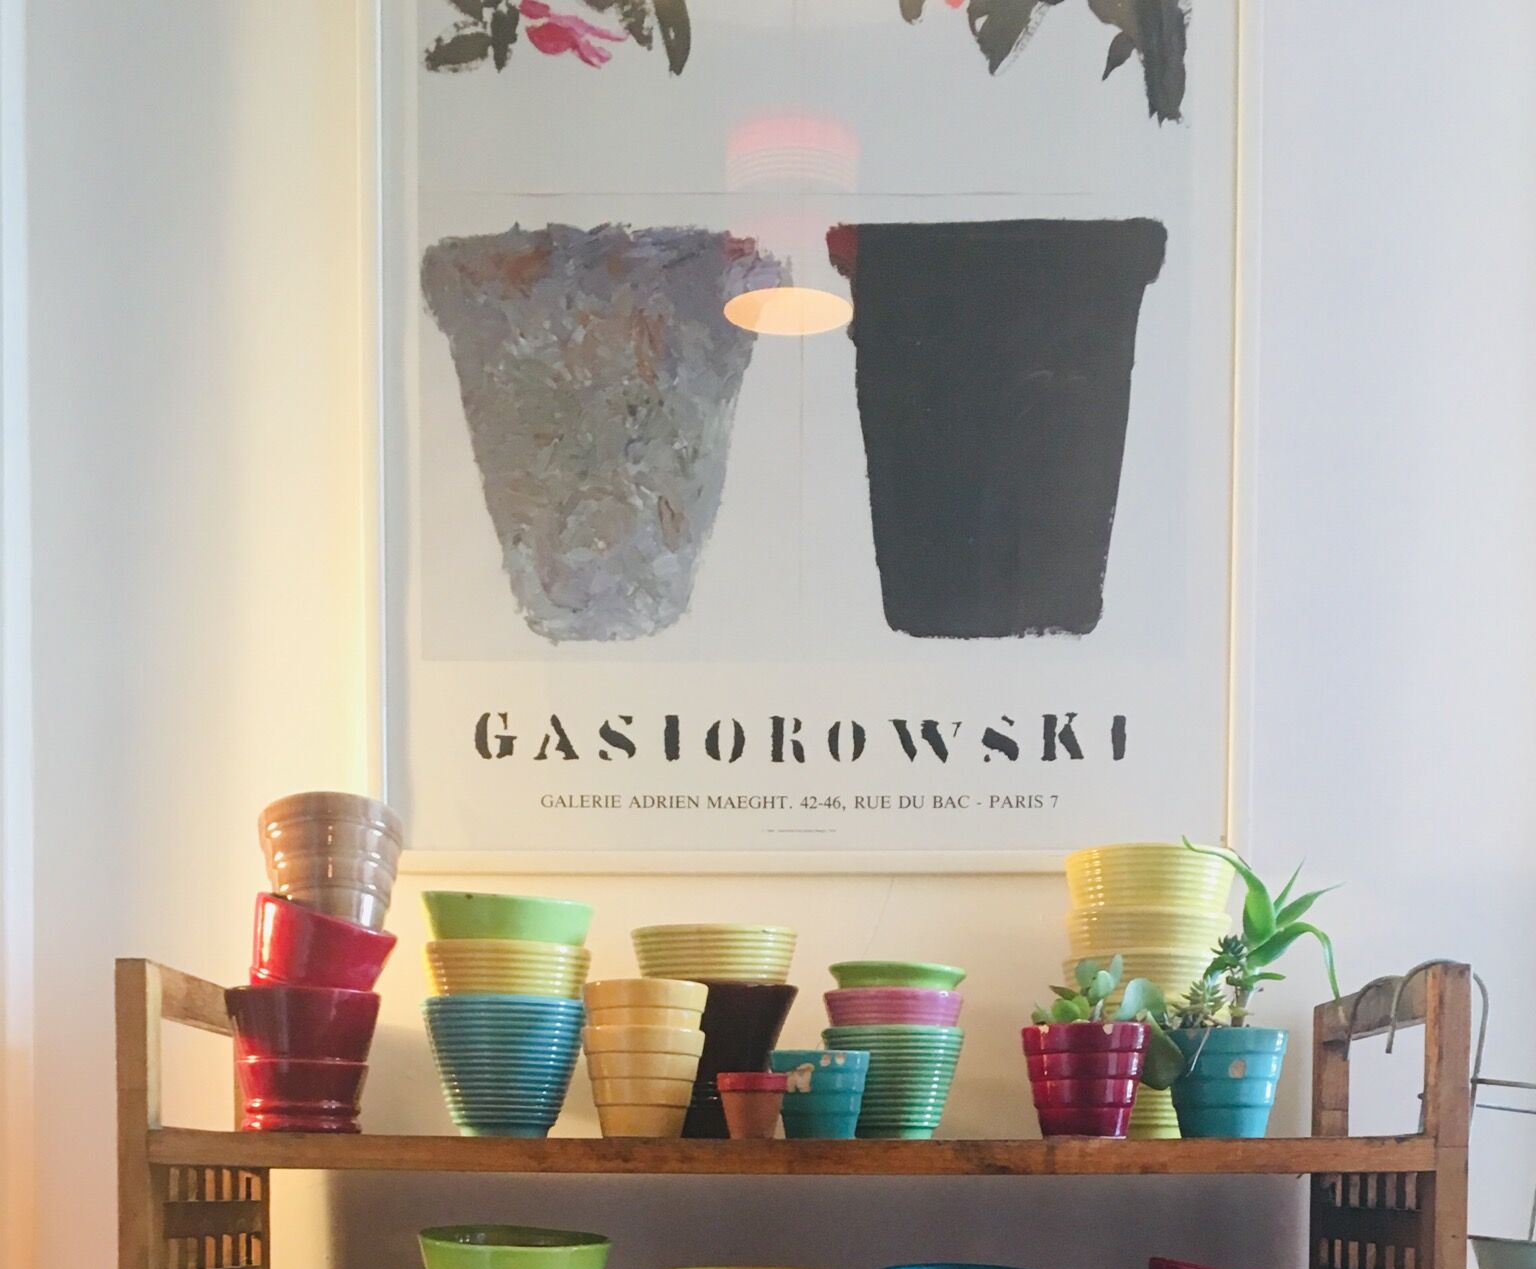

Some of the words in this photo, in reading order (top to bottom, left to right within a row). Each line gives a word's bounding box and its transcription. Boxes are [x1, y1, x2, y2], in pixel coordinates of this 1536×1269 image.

[474, 712, 1128, 764] GASIOROWSKI
[540, 795, 622, 808] GALERIE
[629, 795, 700, 808] ADRIEN
[707, 796, 793, 809] MAEGHT.
[800, 796, 846, 811] 42-46,
[854, 796, 891, 809] RUE
[898, 796, 926, 809] DU
[933, 796, 971, 809] BAC
[989, 795, 1042, 809] PARIS
[1049, 795, 1059, 808] 7
